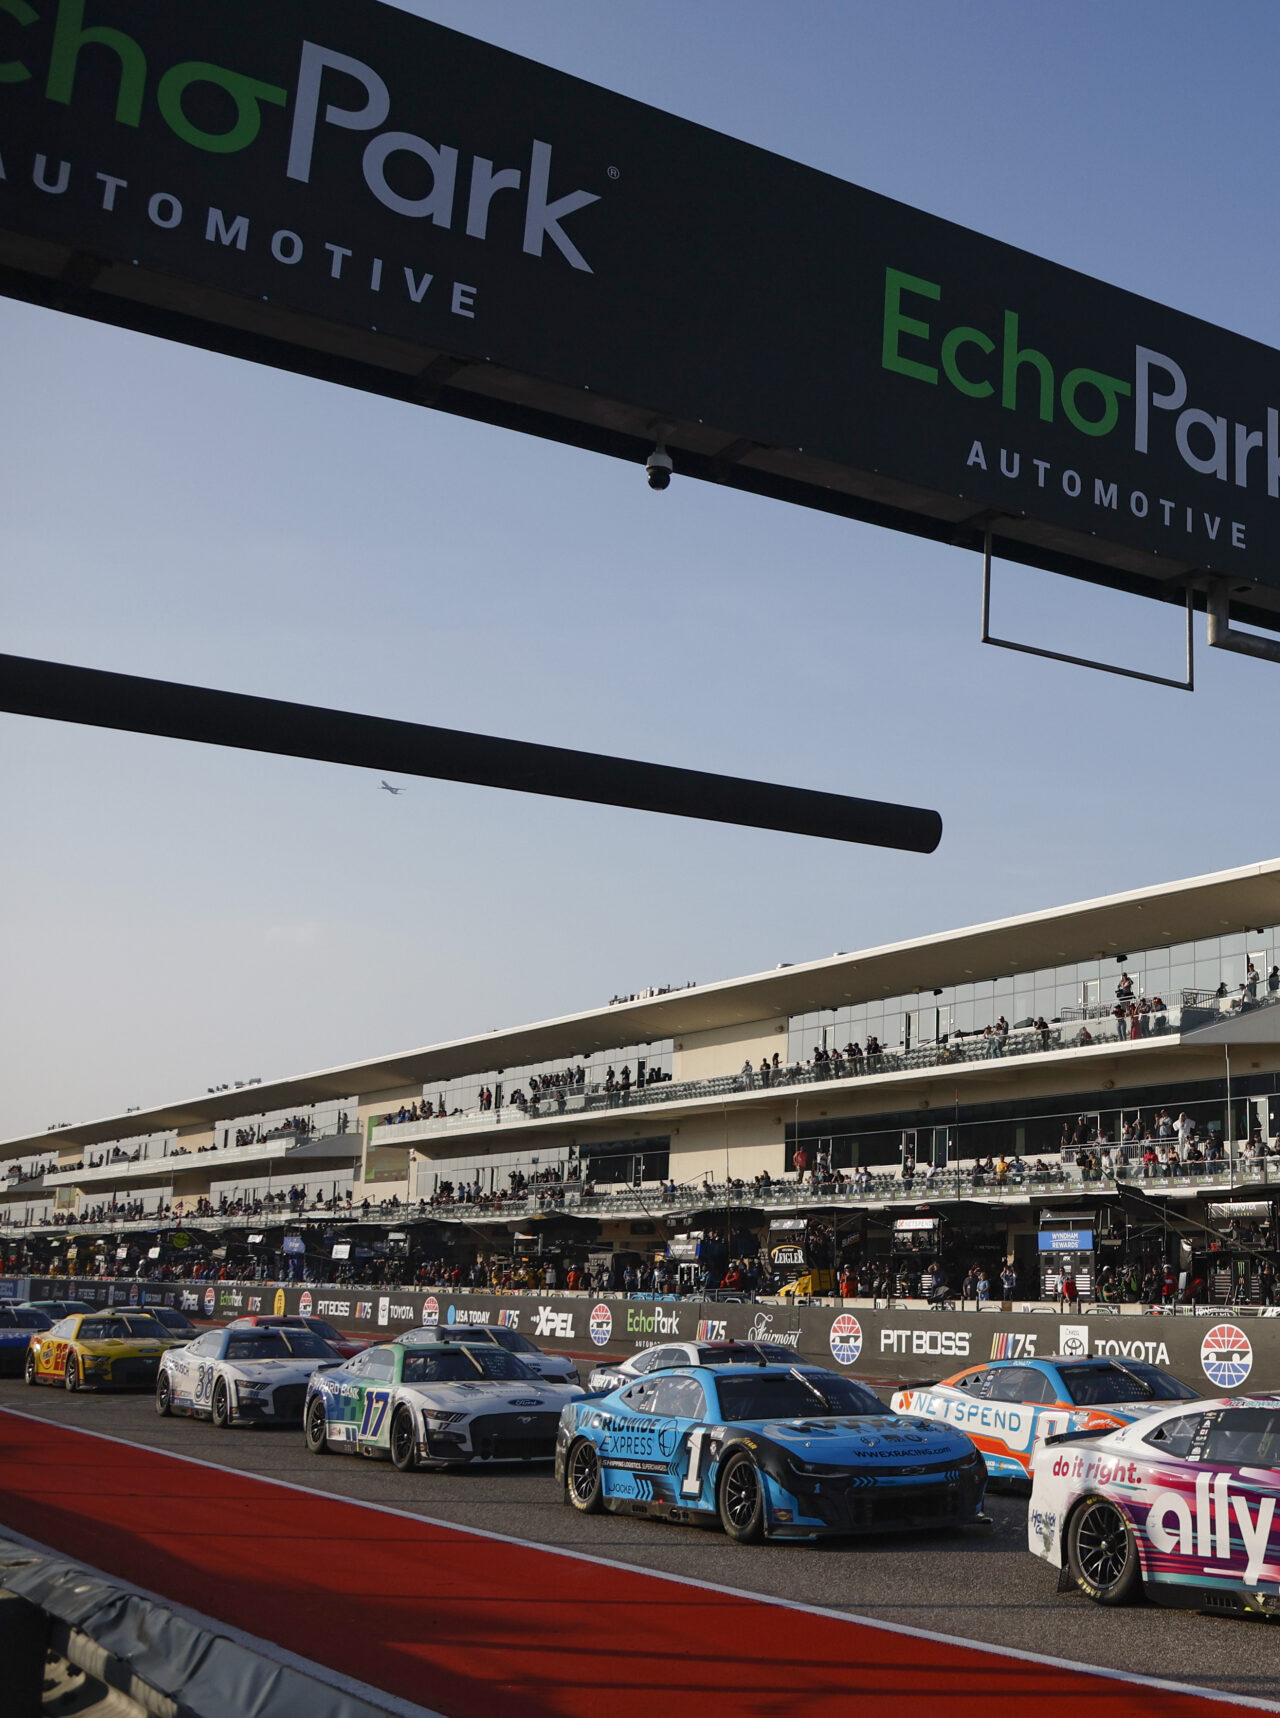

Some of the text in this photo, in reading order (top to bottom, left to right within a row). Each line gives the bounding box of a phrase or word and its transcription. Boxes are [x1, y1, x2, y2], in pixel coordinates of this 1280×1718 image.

[0, 153, 478, 319] UTOMOTIVE
[966, 439, 1248, 550] AUTOMOTIVE
[1052, 1232, 1079, 1240] WYNDHAM
[1052, 1241, 1079, 1249] REWARDS
[774, 1249, 805, 1265] ZEIGLER
[317, 1300, 350, 1317] PIT BOSS
[361, 1302, 372, 1319] 75
[390, 1305, 414, 1320] TOYOTA
[455, 1309, 491, 1324] USA TODAY
[507, 1310, 520, 1330] 75
[536, 1306, 576, 1338] XPEL
[627, 1306, 679, 1335] EchoPark
[711, 1320, 727, 1340] 75
[747, 1312, 804, 1348] Fairmont
[880, 1329, 970, 1356] PIT BOSS
[1013, 1333, 1038, 1359] 75
[1095, 1339, 1170, 1365] TOYOTA
[195, 1362, 215, 1403] 38
[591, 1374, 615, 1388] LIBERTY
[340, 1384, 360, 1400] BANK
[514, 1399, 538, 1407] Ford
[913, 1392, 1021, 1433] NETSPEND
[360, 1390, 392, 1439] 17
[580, 1408, 662, 1434] WORLDWIDE
[438, 1422, 450, 1431] 17
[600, 1435, 654, 1456] EXPRESS
[853, 1446, 952, 1458] WWEXRACING.com
[680, 1426, 707, 1497] 1
[1053, 1455, 1143, 1486] do it right.
[609, 1484, 635, 1494] JOCKEY
[812, 1482, 821, 1494] 1
[1146, 1472, 1276, 1586] ally
